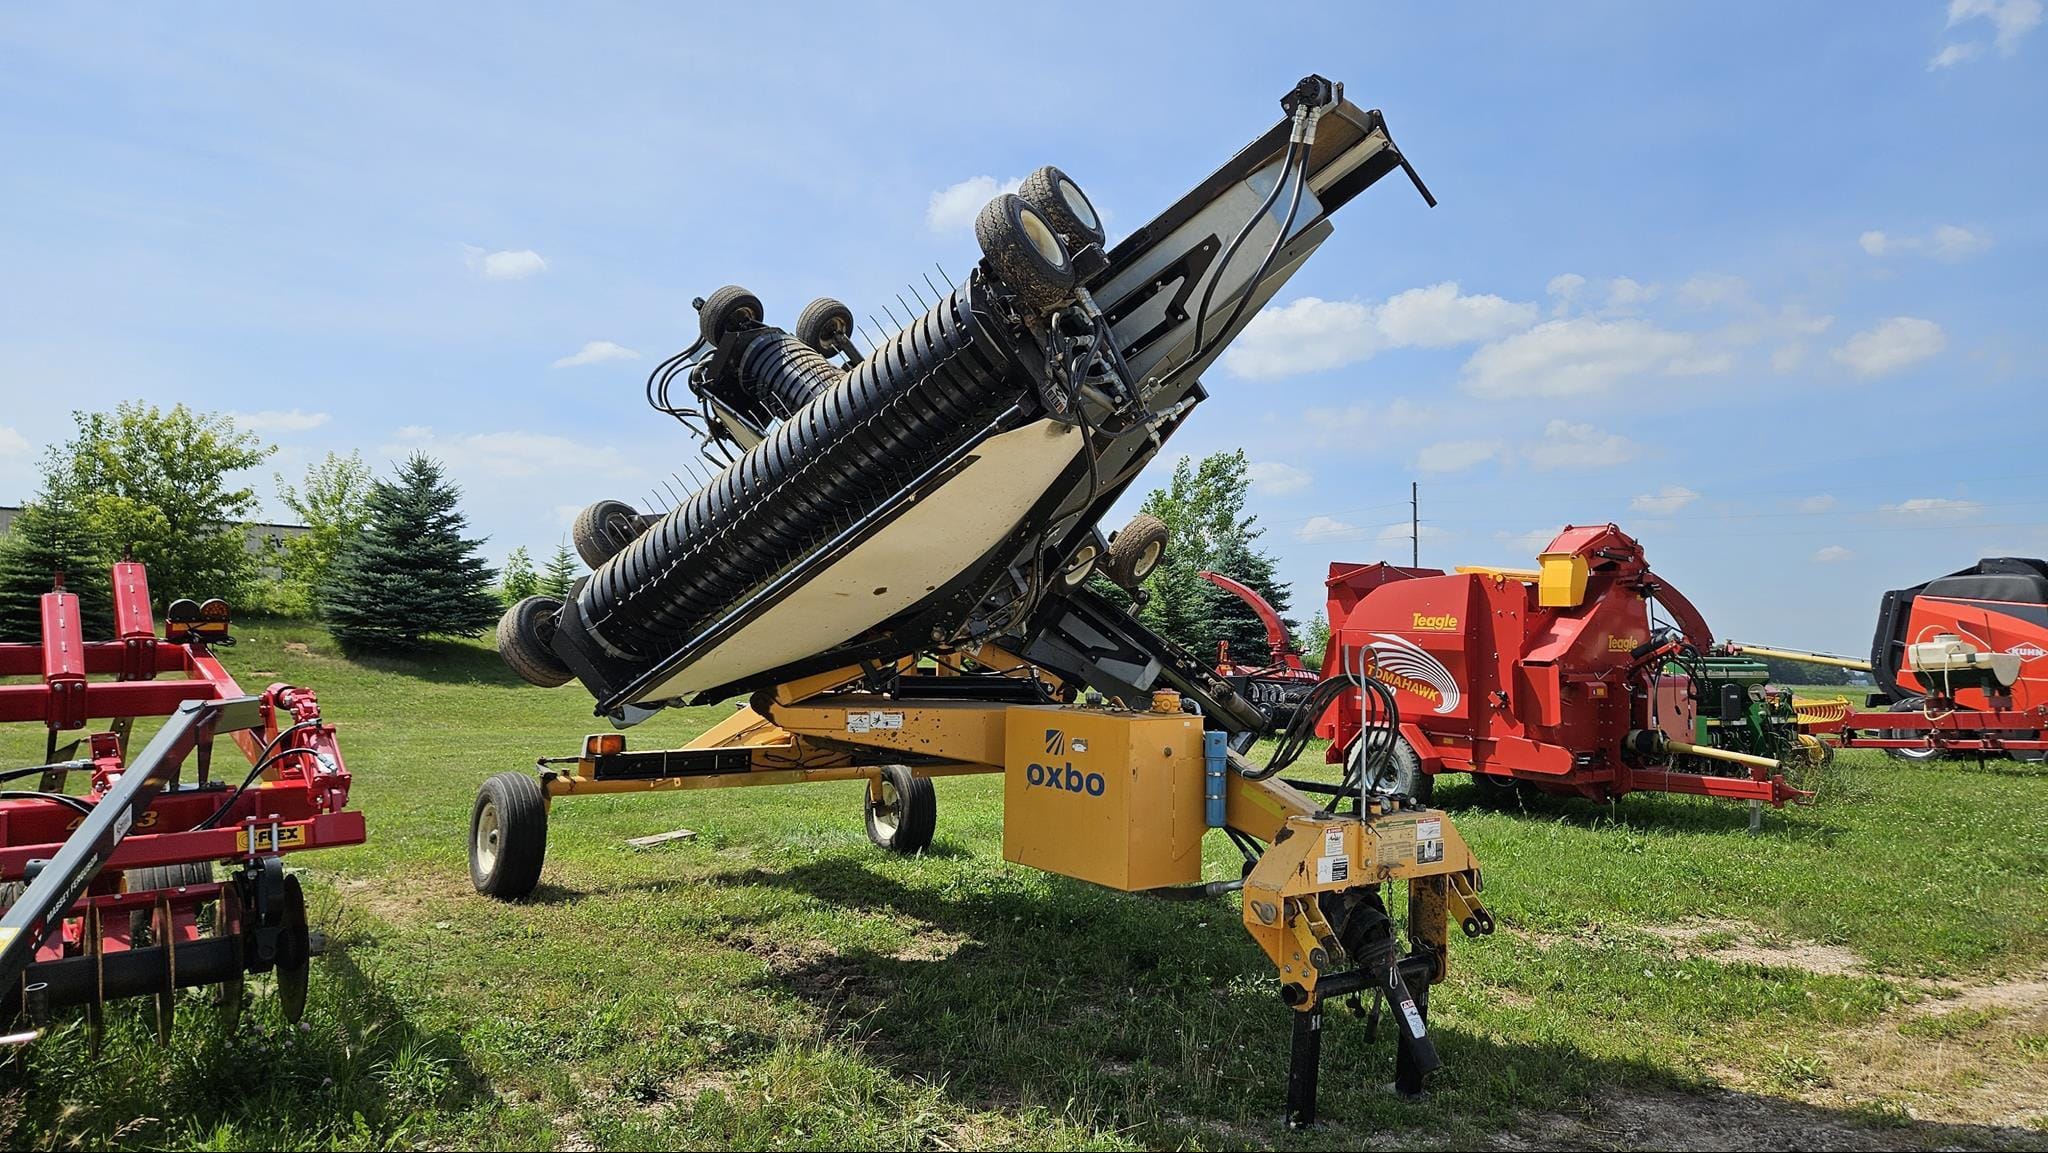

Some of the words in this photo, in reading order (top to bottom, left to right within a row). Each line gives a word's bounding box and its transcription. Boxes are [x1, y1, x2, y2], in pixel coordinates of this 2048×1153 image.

[1413, 612, 1458, 630] Teagle
[1608, 634, 1638, 652] Teagle
[2010, 648, 2044, 657] KUHN
[1367, 663, 1440, 702] TOMAHAWK
[1026, 761, 1105, 797] oxbo
